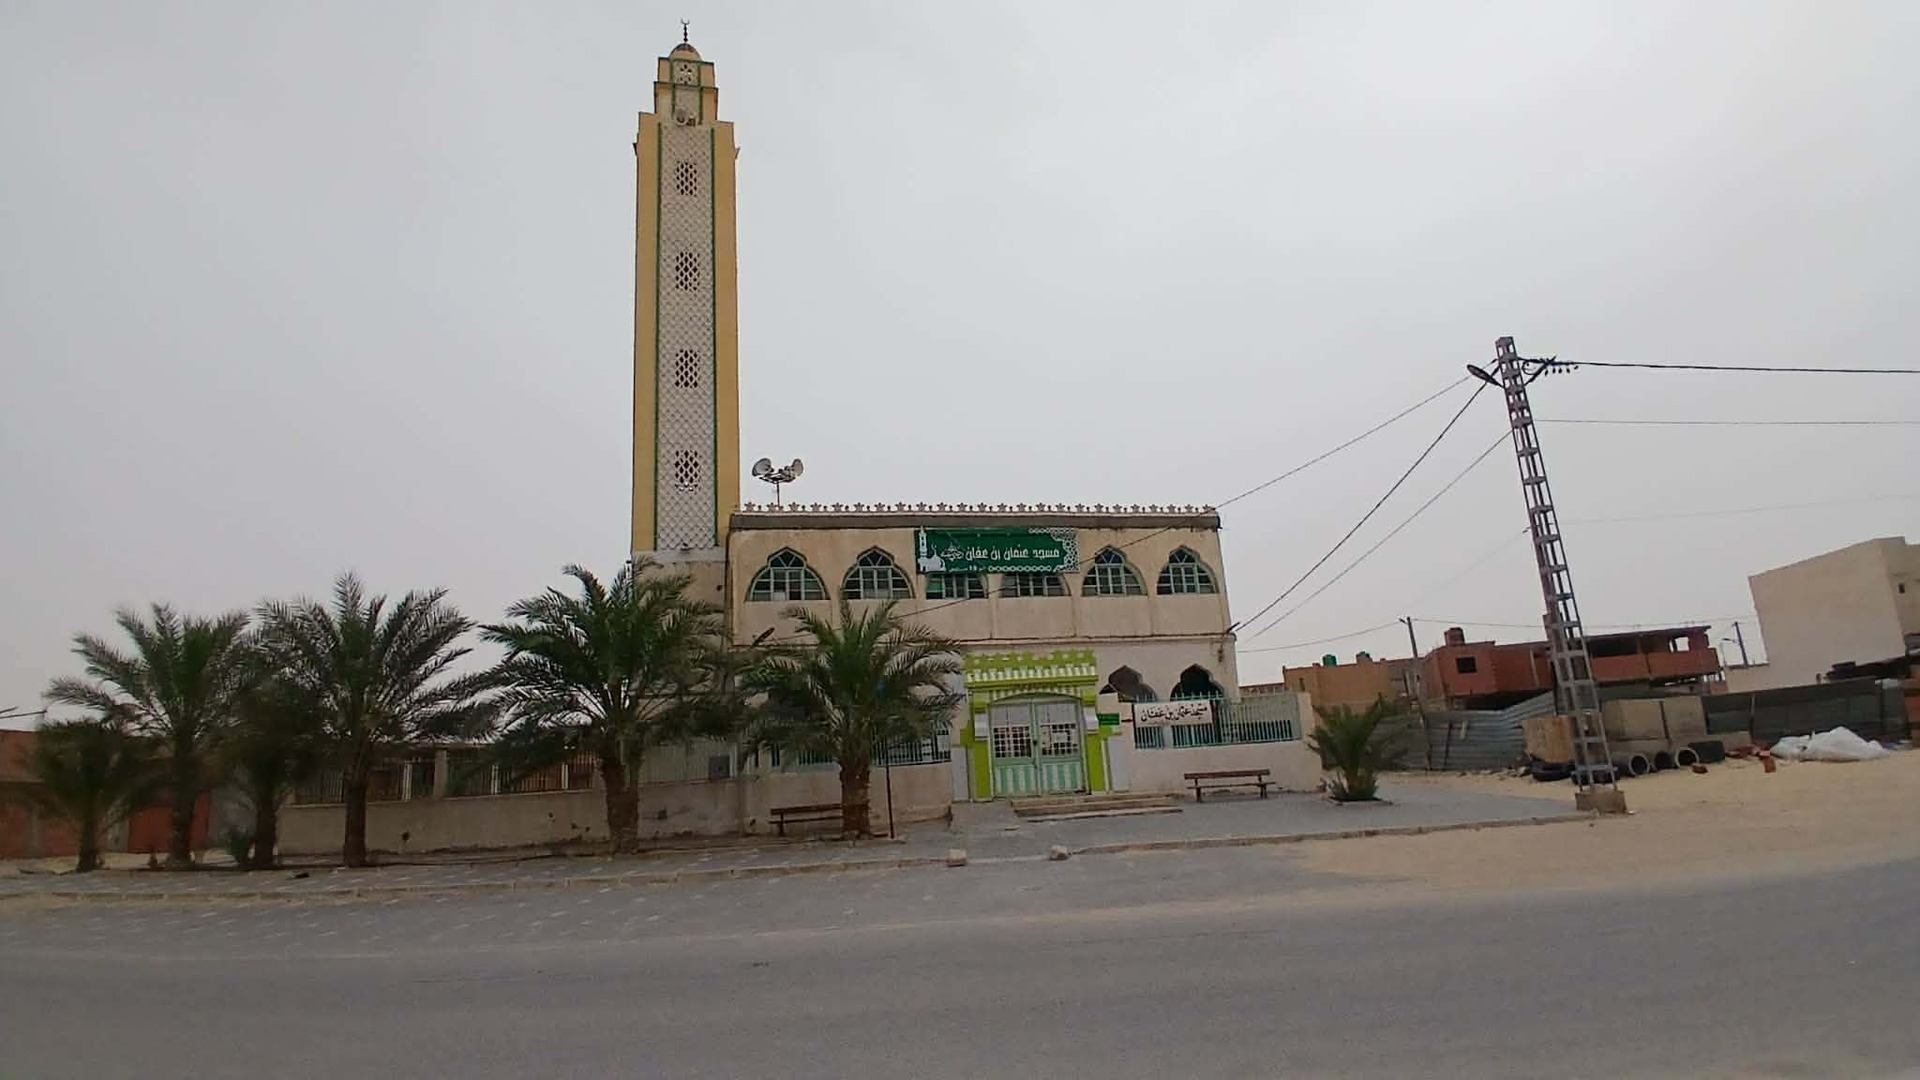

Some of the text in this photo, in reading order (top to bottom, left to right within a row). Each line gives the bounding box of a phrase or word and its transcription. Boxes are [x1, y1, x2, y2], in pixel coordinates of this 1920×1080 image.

[965, 546, 989, 561] عفان
[1004, 544, 1030, 560] عثمان
[1032, 547, 1060, 560] مسجد
[1140, 706, 1165, 722] عفان
[1190, 703, 1208, 720] مسجد
